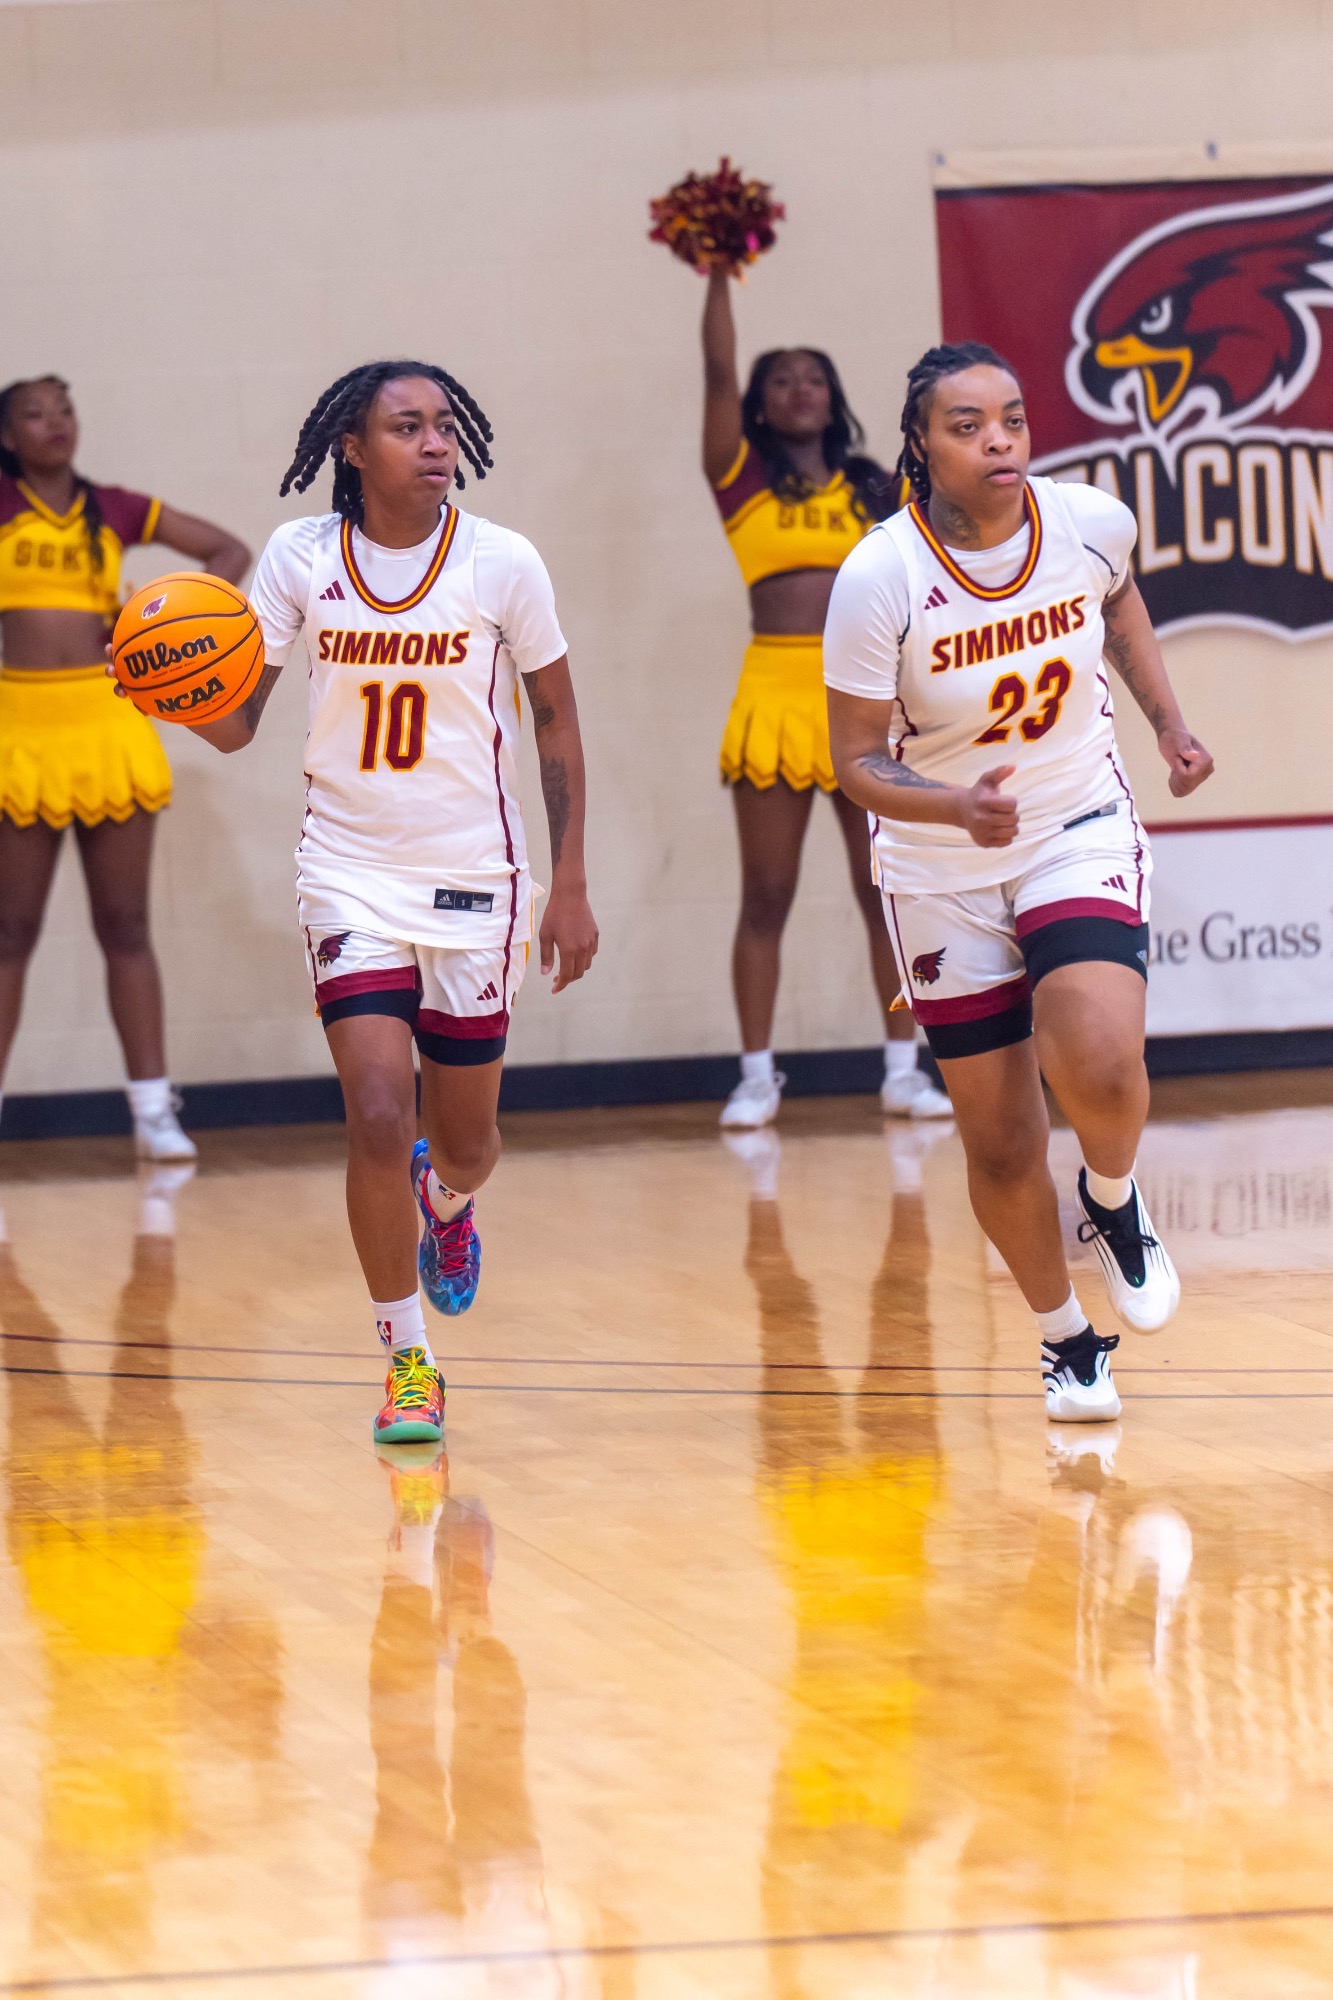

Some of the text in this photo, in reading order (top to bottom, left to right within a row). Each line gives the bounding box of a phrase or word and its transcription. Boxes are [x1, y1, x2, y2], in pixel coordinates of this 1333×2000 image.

[1050, 438, 1333, 584] LCON
[123, 634, 219, 680] Wilson
[318, 628, 470, 667] SIMMONS
[930, 594, 1086, 674] SIMMONS
[154, 675, 226, 713] NCAA
[359, 680, 429, 772] 10
[971, 656, 1073, 745] 23
[1150, 928, 1189, 965] ue
[1200, 910, 1322, 963] Grass
